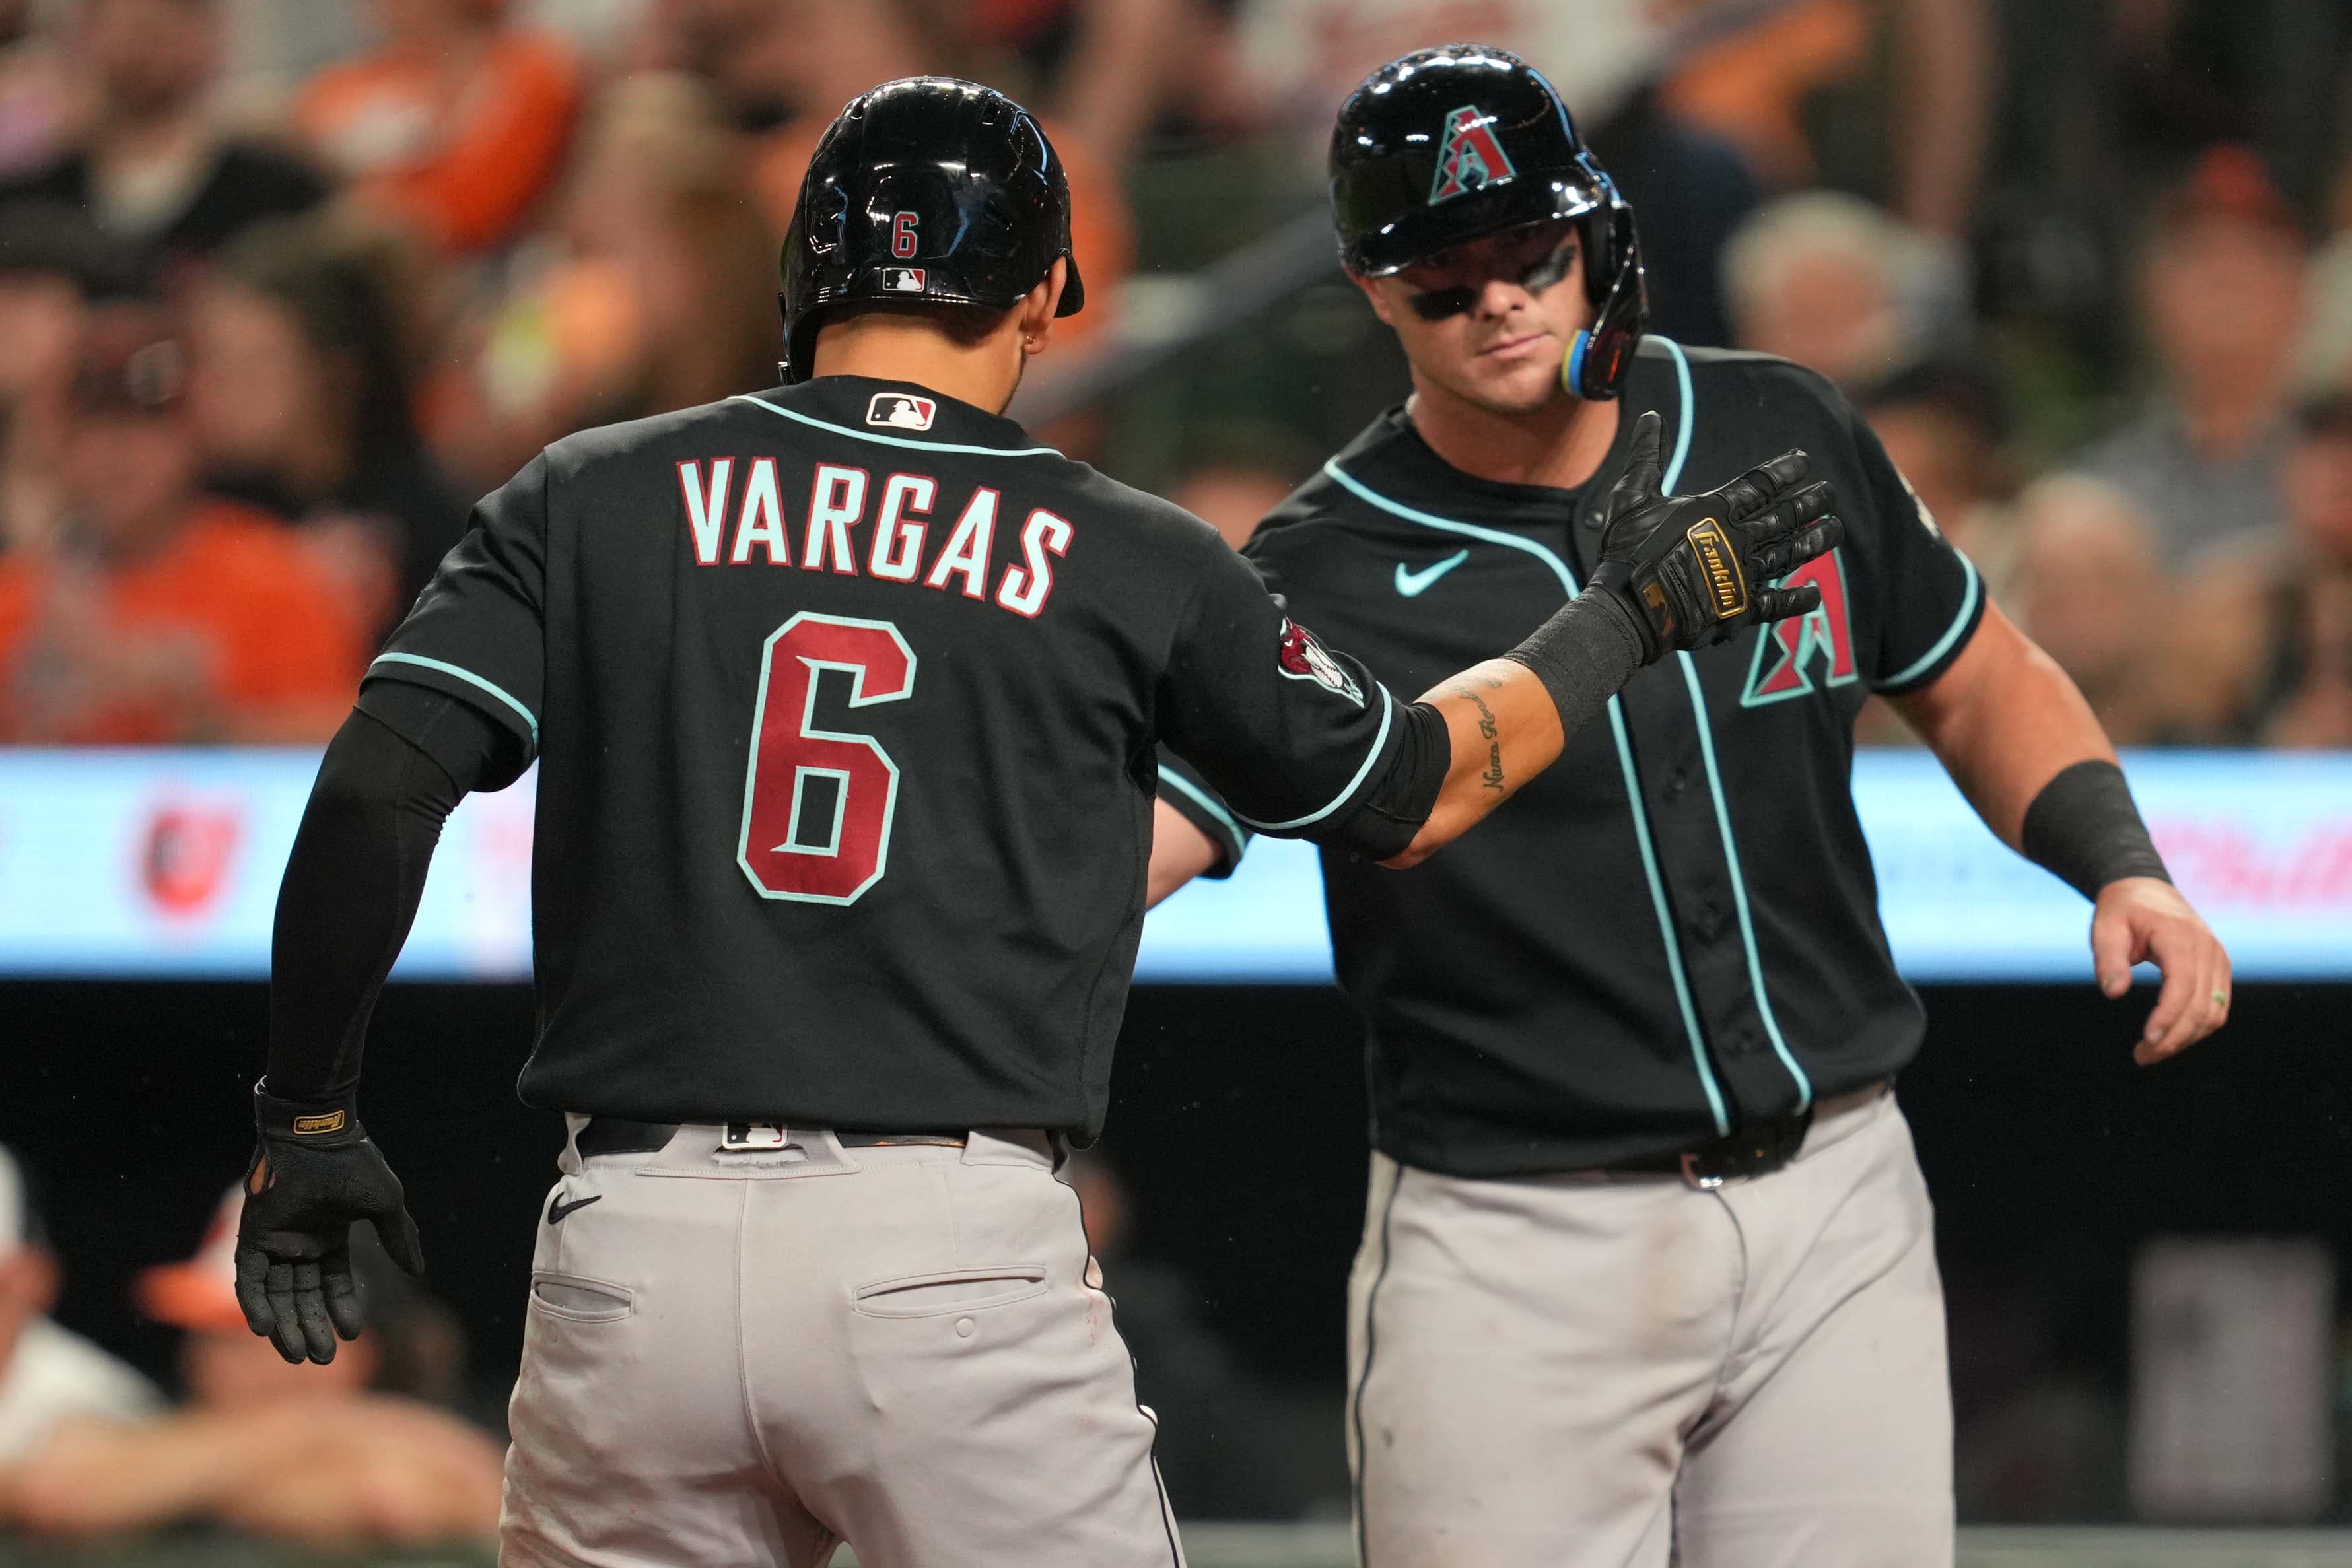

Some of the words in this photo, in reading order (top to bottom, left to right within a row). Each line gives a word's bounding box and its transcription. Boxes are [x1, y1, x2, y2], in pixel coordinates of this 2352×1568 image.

[891, 211, 919, 259] 6
[675, 456, 1075, 619] VARGAS
[1694, 531, 1737, 607] Franklin
[736, 610, 917, 907] 6
